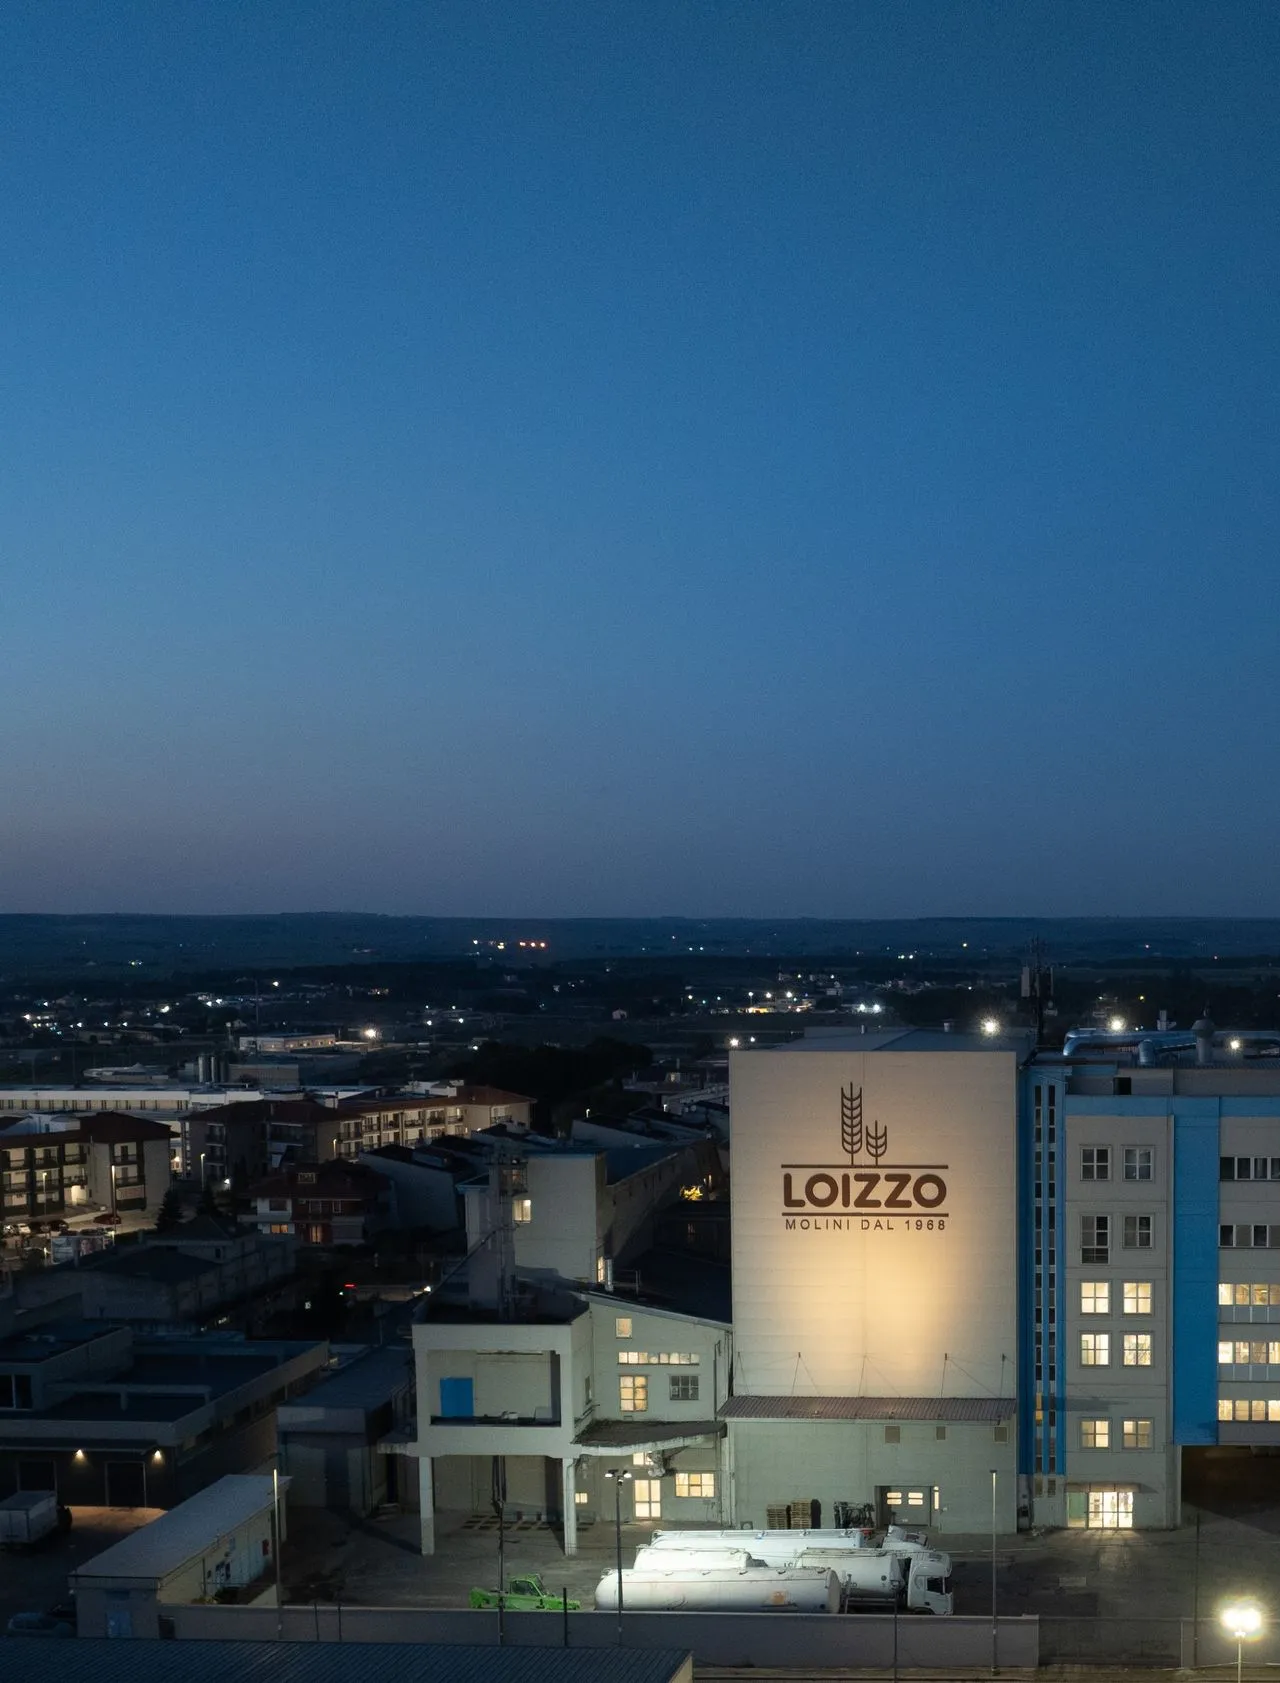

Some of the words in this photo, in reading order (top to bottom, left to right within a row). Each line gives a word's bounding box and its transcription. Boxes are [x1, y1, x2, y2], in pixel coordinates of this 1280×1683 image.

[784, 1173, 947, 1208] LOIZZO
[785, 1219, 850, 1230] MOLINI
[861, 1219, 894, 1230] DAL
[905, 1219, 946, 1231] 1968
